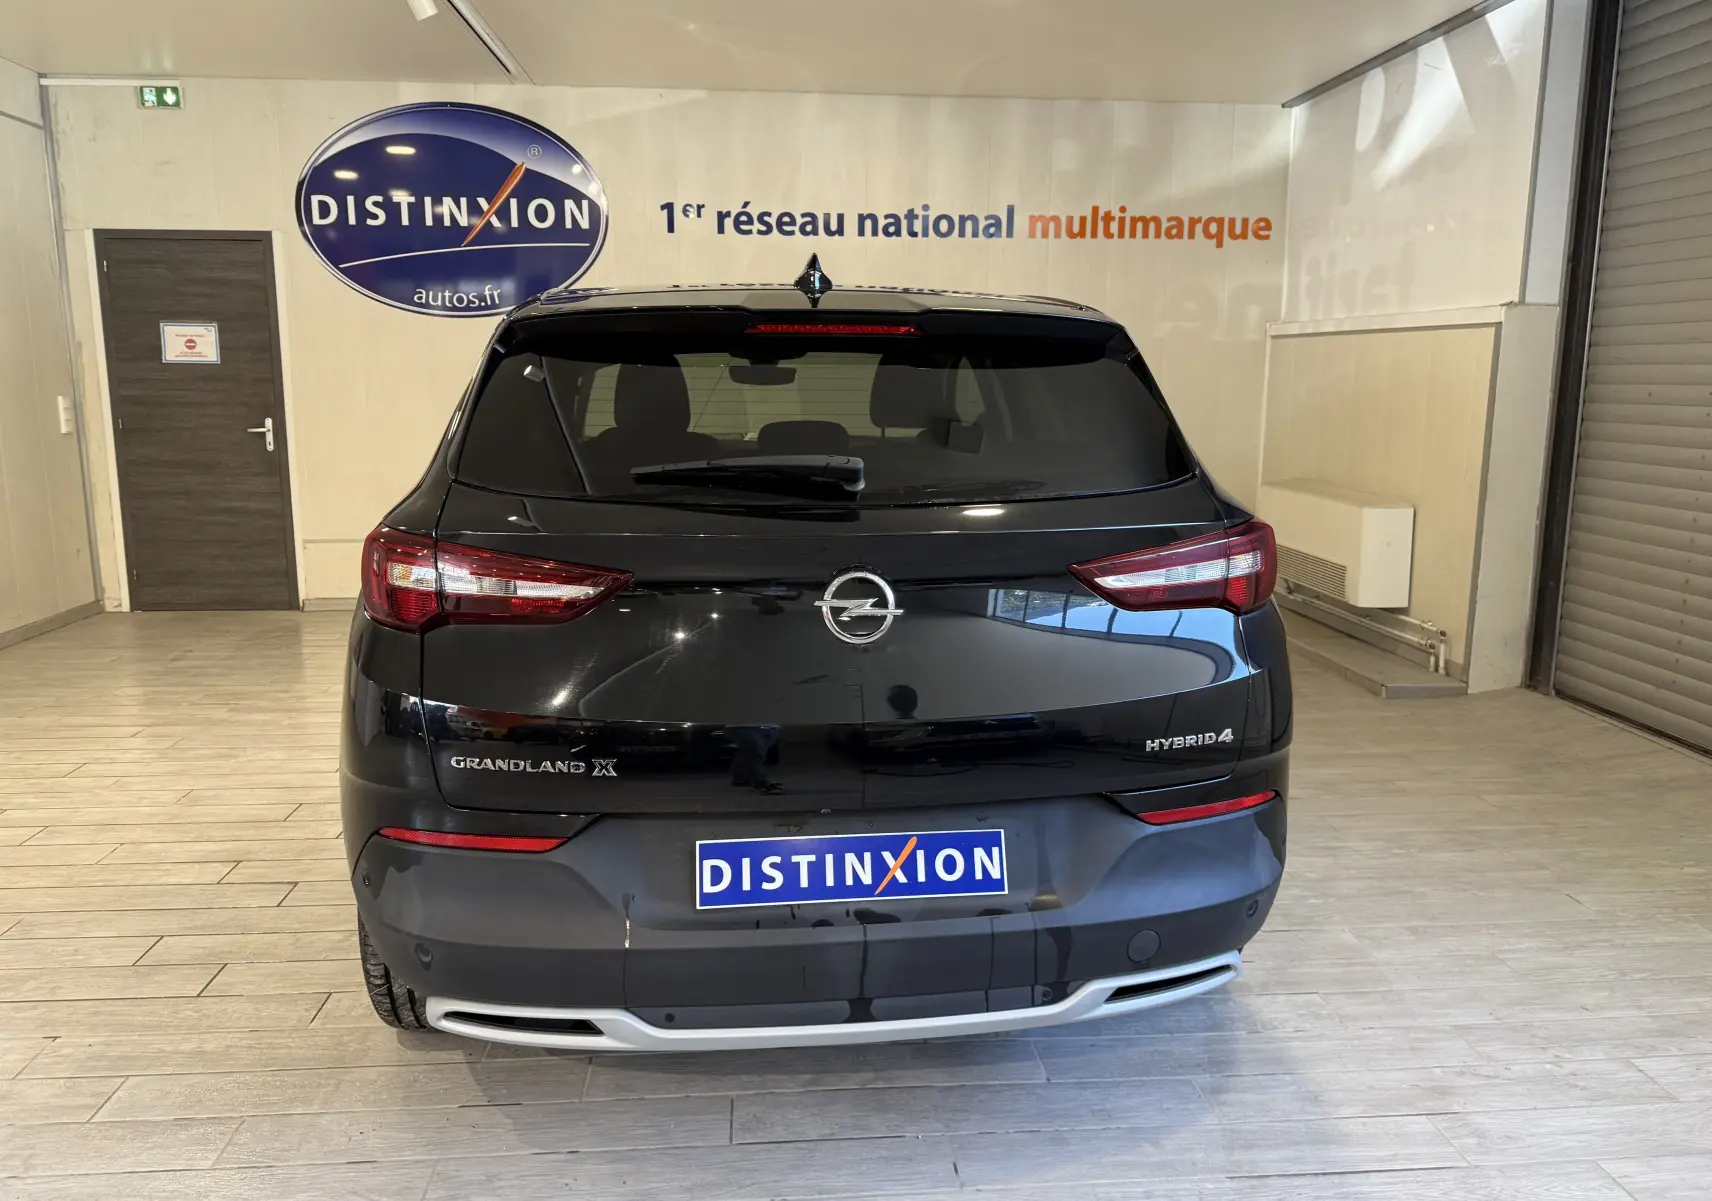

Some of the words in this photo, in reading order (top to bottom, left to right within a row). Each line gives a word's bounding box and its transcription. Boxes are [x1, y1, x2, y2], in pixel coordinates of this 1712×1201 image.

[660, 201, 705, 234] 1er
[716, 201, 845, 237] réseau
[857, 203, 1015, 238] national
[1027, 205, 1273, 249] multimarque
[413, 284, 501, 308] autos.fr
[1145, 728, 1234, 752] HYBRID4
[450, 756, 586, 774] GRANDLAND
[591, 758, 618, 777] X
[702, 836, 1002, 896] DISTINXION
